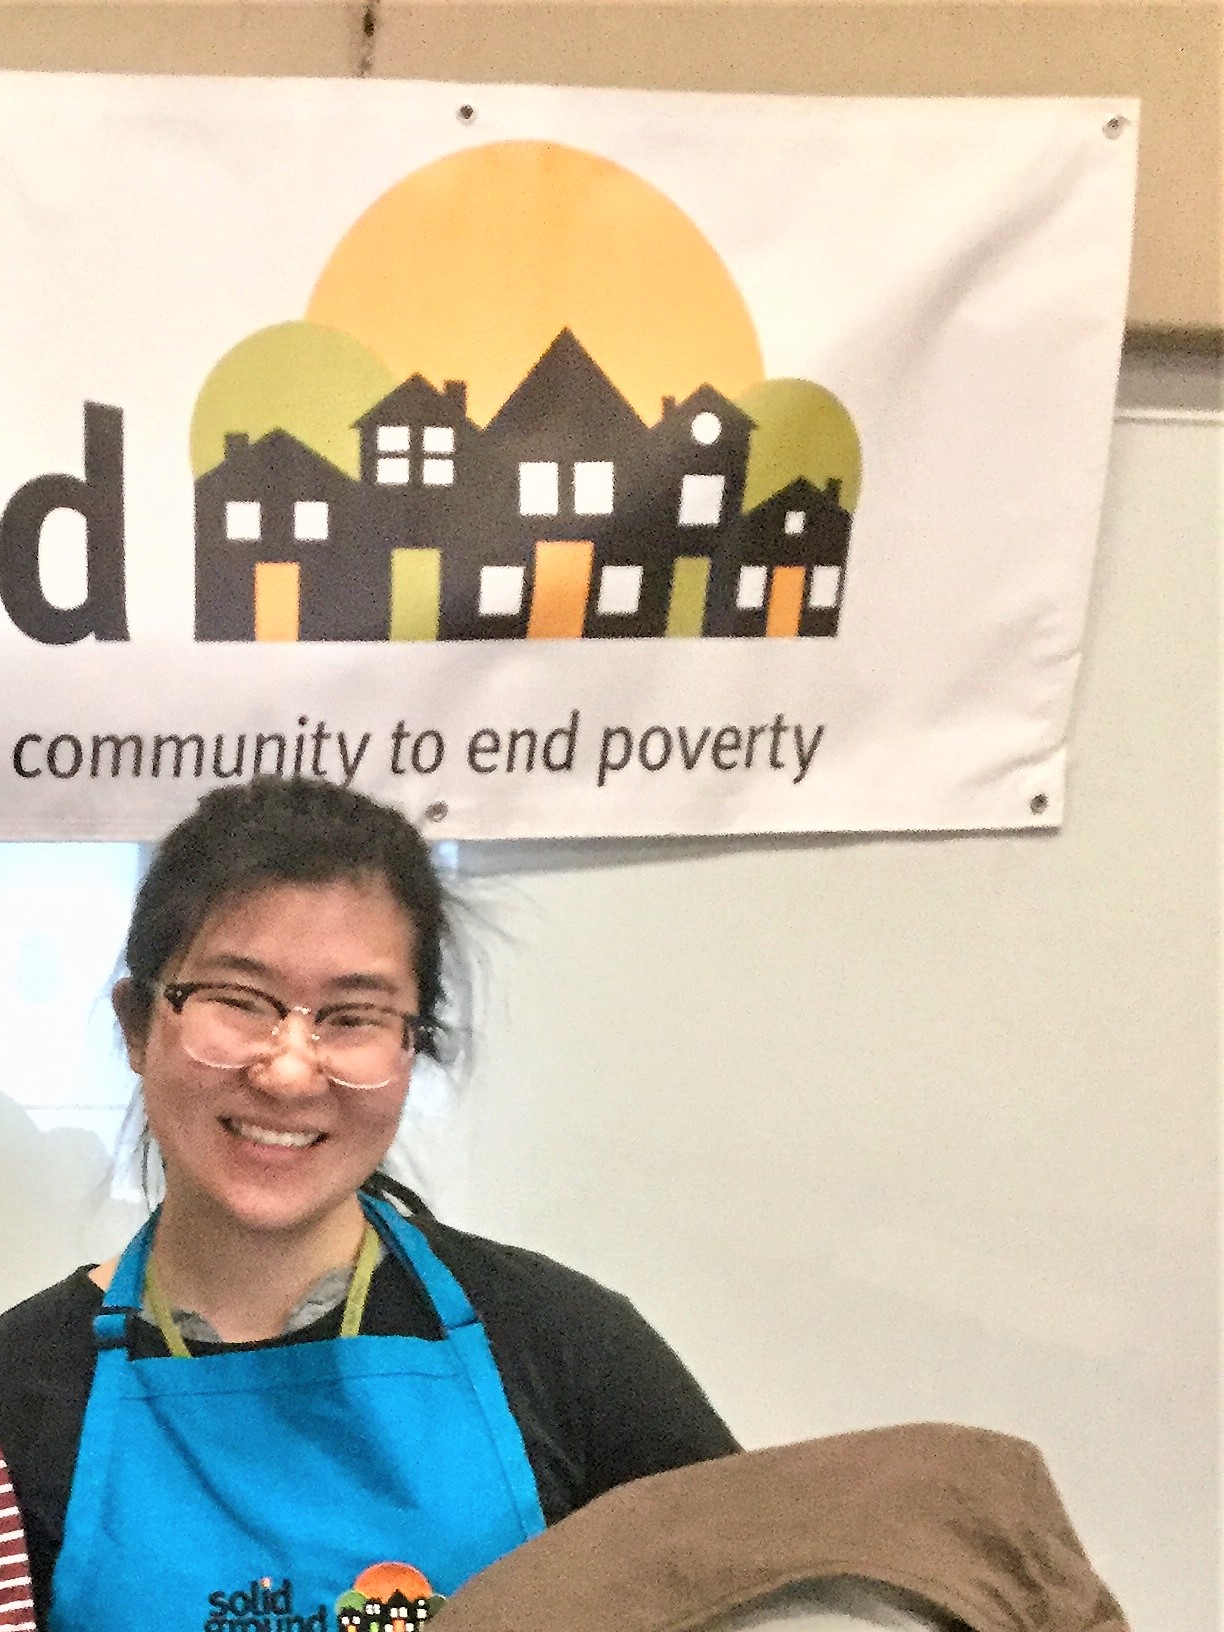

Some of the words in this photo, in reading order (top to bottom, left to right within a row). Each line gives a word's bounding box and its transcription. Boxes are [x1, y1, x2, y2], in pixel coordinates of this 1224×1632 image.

[12, 715, 372, 787] community
[390, 719, 445, 774] to
[467, 709, 580, 773] end
[597, 712, 825, 787] poverty
[208, 1578, 292, 1616] solid
